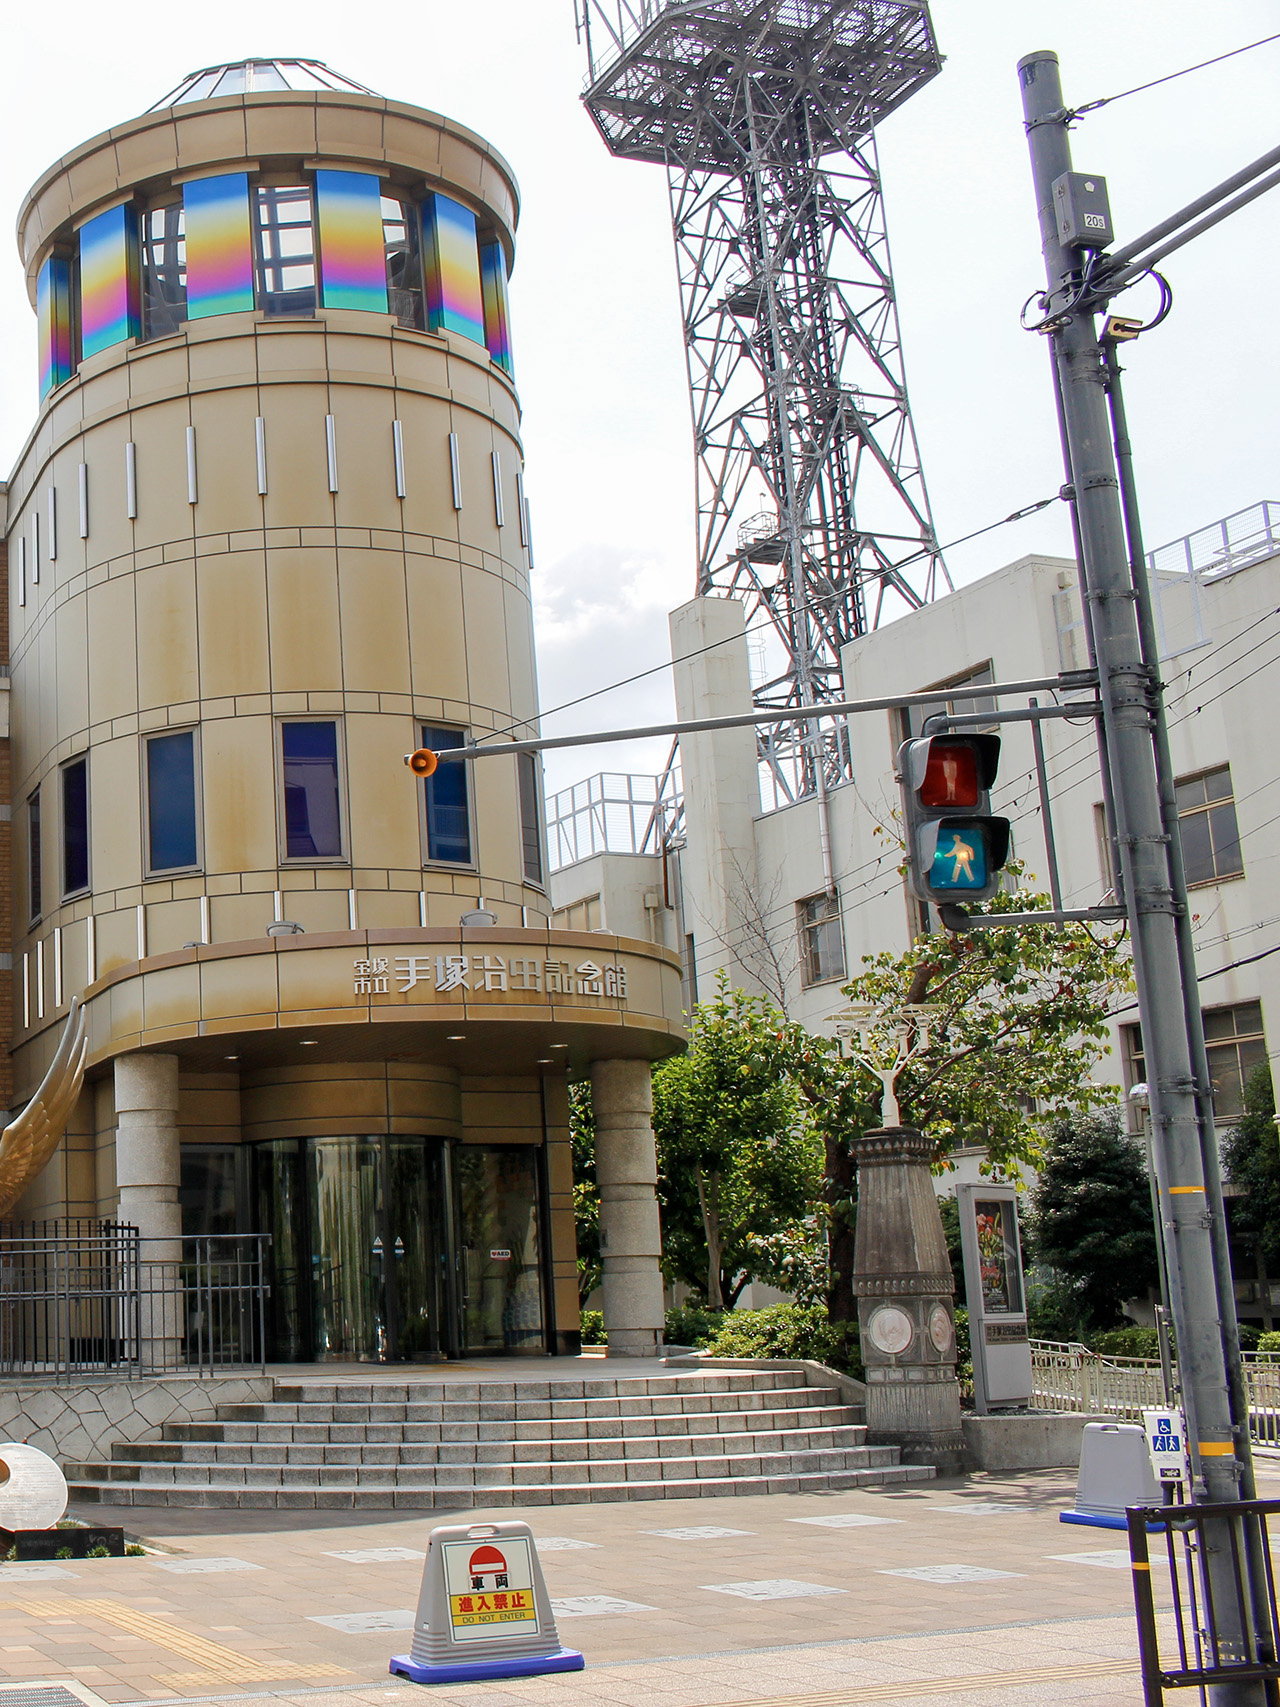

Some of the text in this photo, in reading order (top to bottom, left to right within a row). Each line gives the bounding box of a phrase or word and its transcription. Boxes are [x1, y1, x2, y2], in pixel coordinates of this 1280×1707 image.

[353, 957, 389, 976] 宝塚
[353, 976, 390, 995] 市立
[394, 955, 628, 999] 手塚治虫記念館
[470, 1573, 509, 1591] 車両
[458, 1592, 526, 1613] 進入禁止
[462, 1612, 526, 1624] DO NOT ENTER
